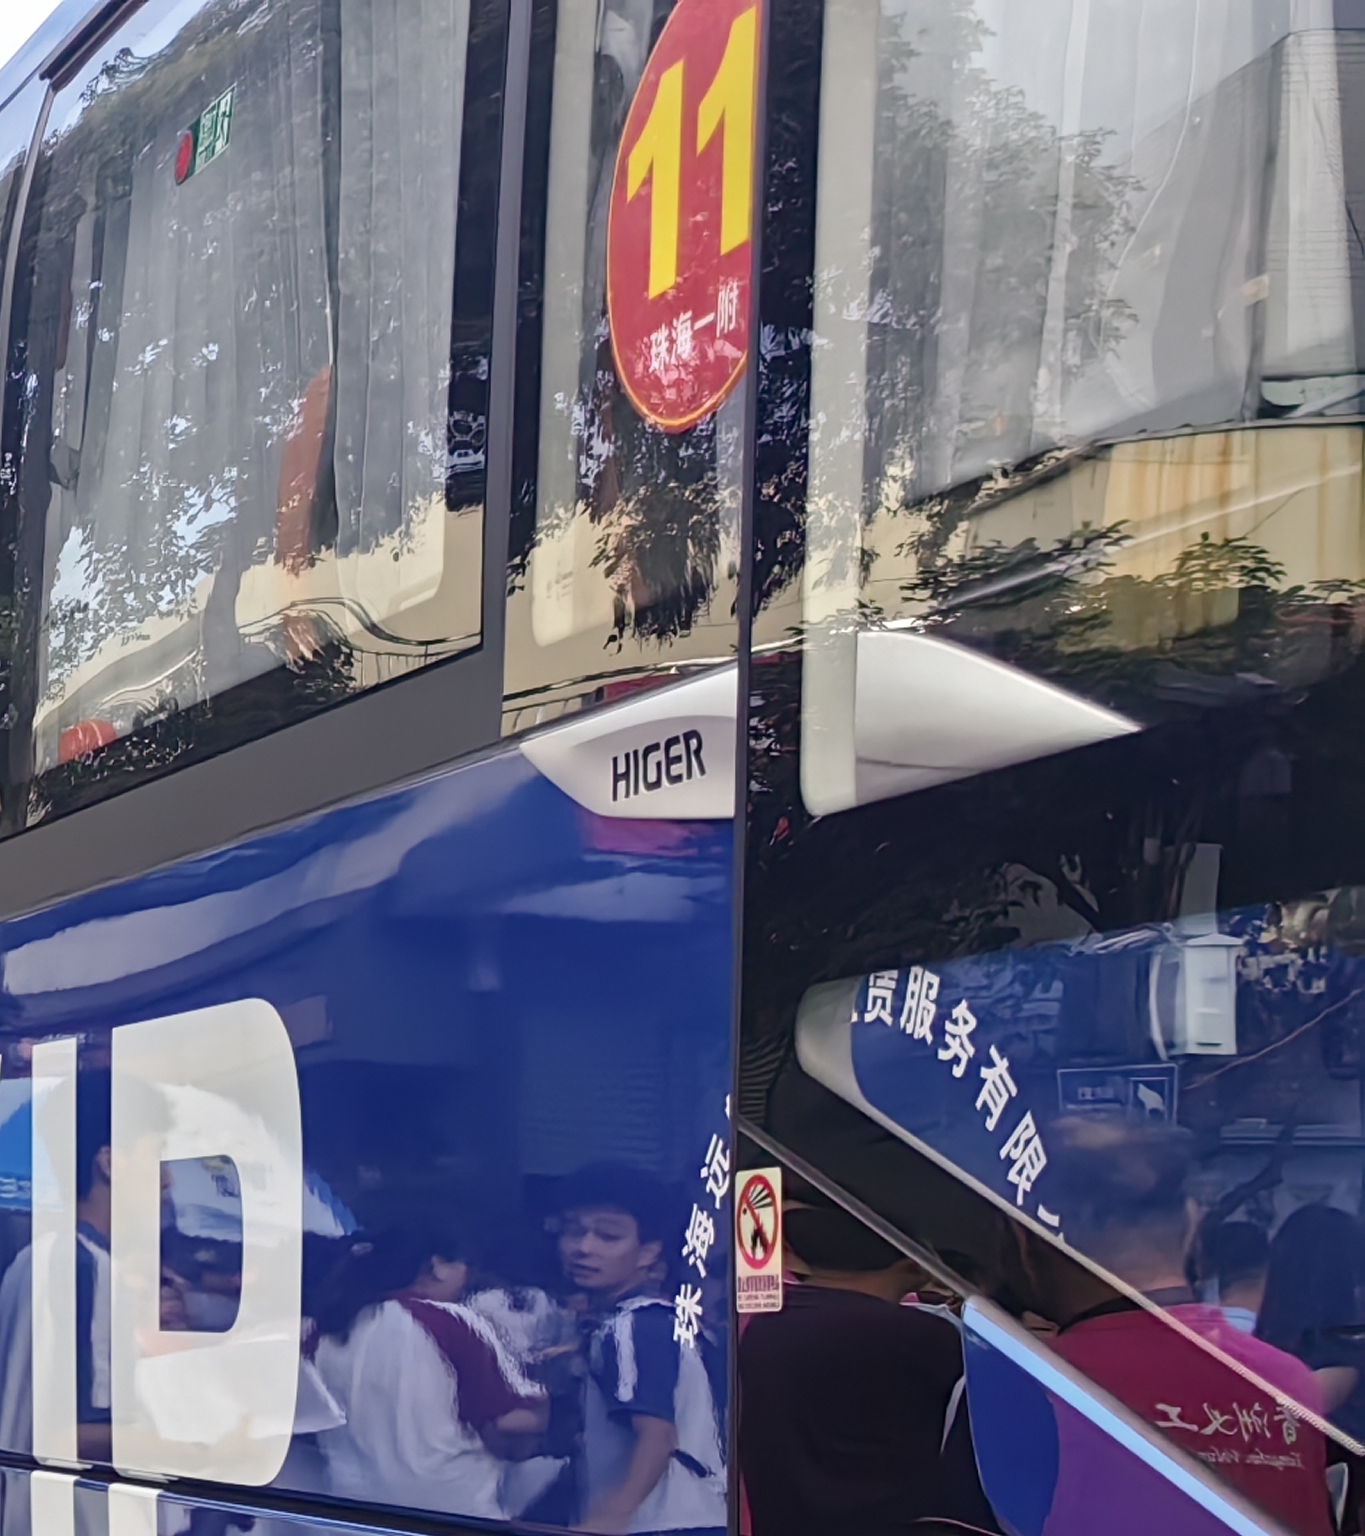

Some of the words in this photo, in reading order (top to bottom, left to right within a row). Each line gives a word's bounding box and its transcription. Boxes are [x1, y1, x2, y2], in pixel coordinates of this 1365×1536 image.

[627, 4, 756, 300] 11
[612, 729, 706, 802] HIGER
[673, 1093, 730, 1349] 珠海远
[851, 965, 1066, 1247] 赁服务有限
